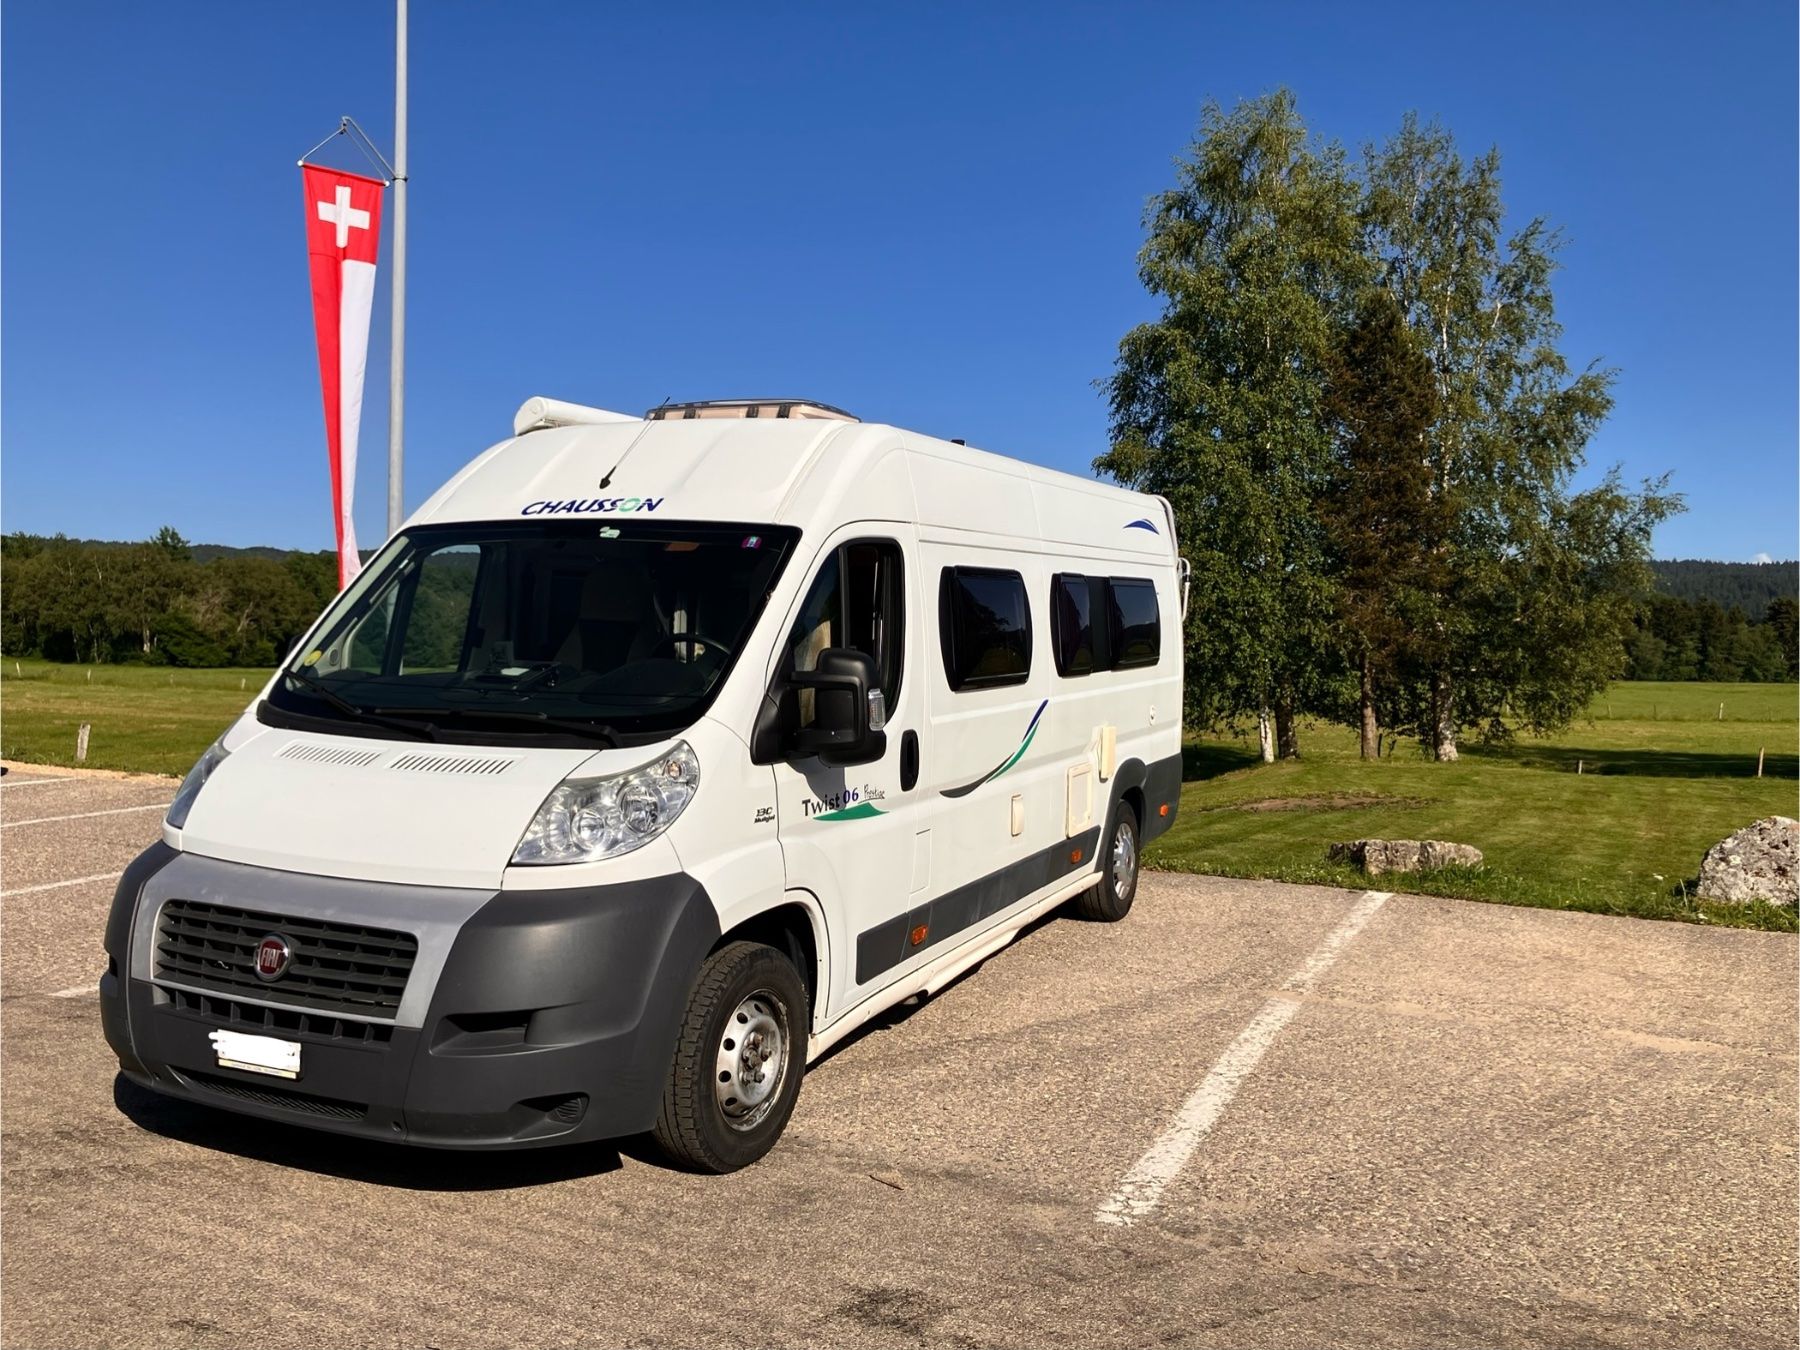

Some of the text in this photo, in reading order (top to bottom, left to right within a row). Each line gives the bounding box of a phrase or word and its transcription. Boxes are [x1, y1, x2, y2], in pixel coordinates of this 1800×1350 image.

[521, 497, 664, 516] CHAUSSON
[801, 792, 841, 816] Twist
[842, 787, 859, 804] 06
[260, 947, 284, 968] FIAT
